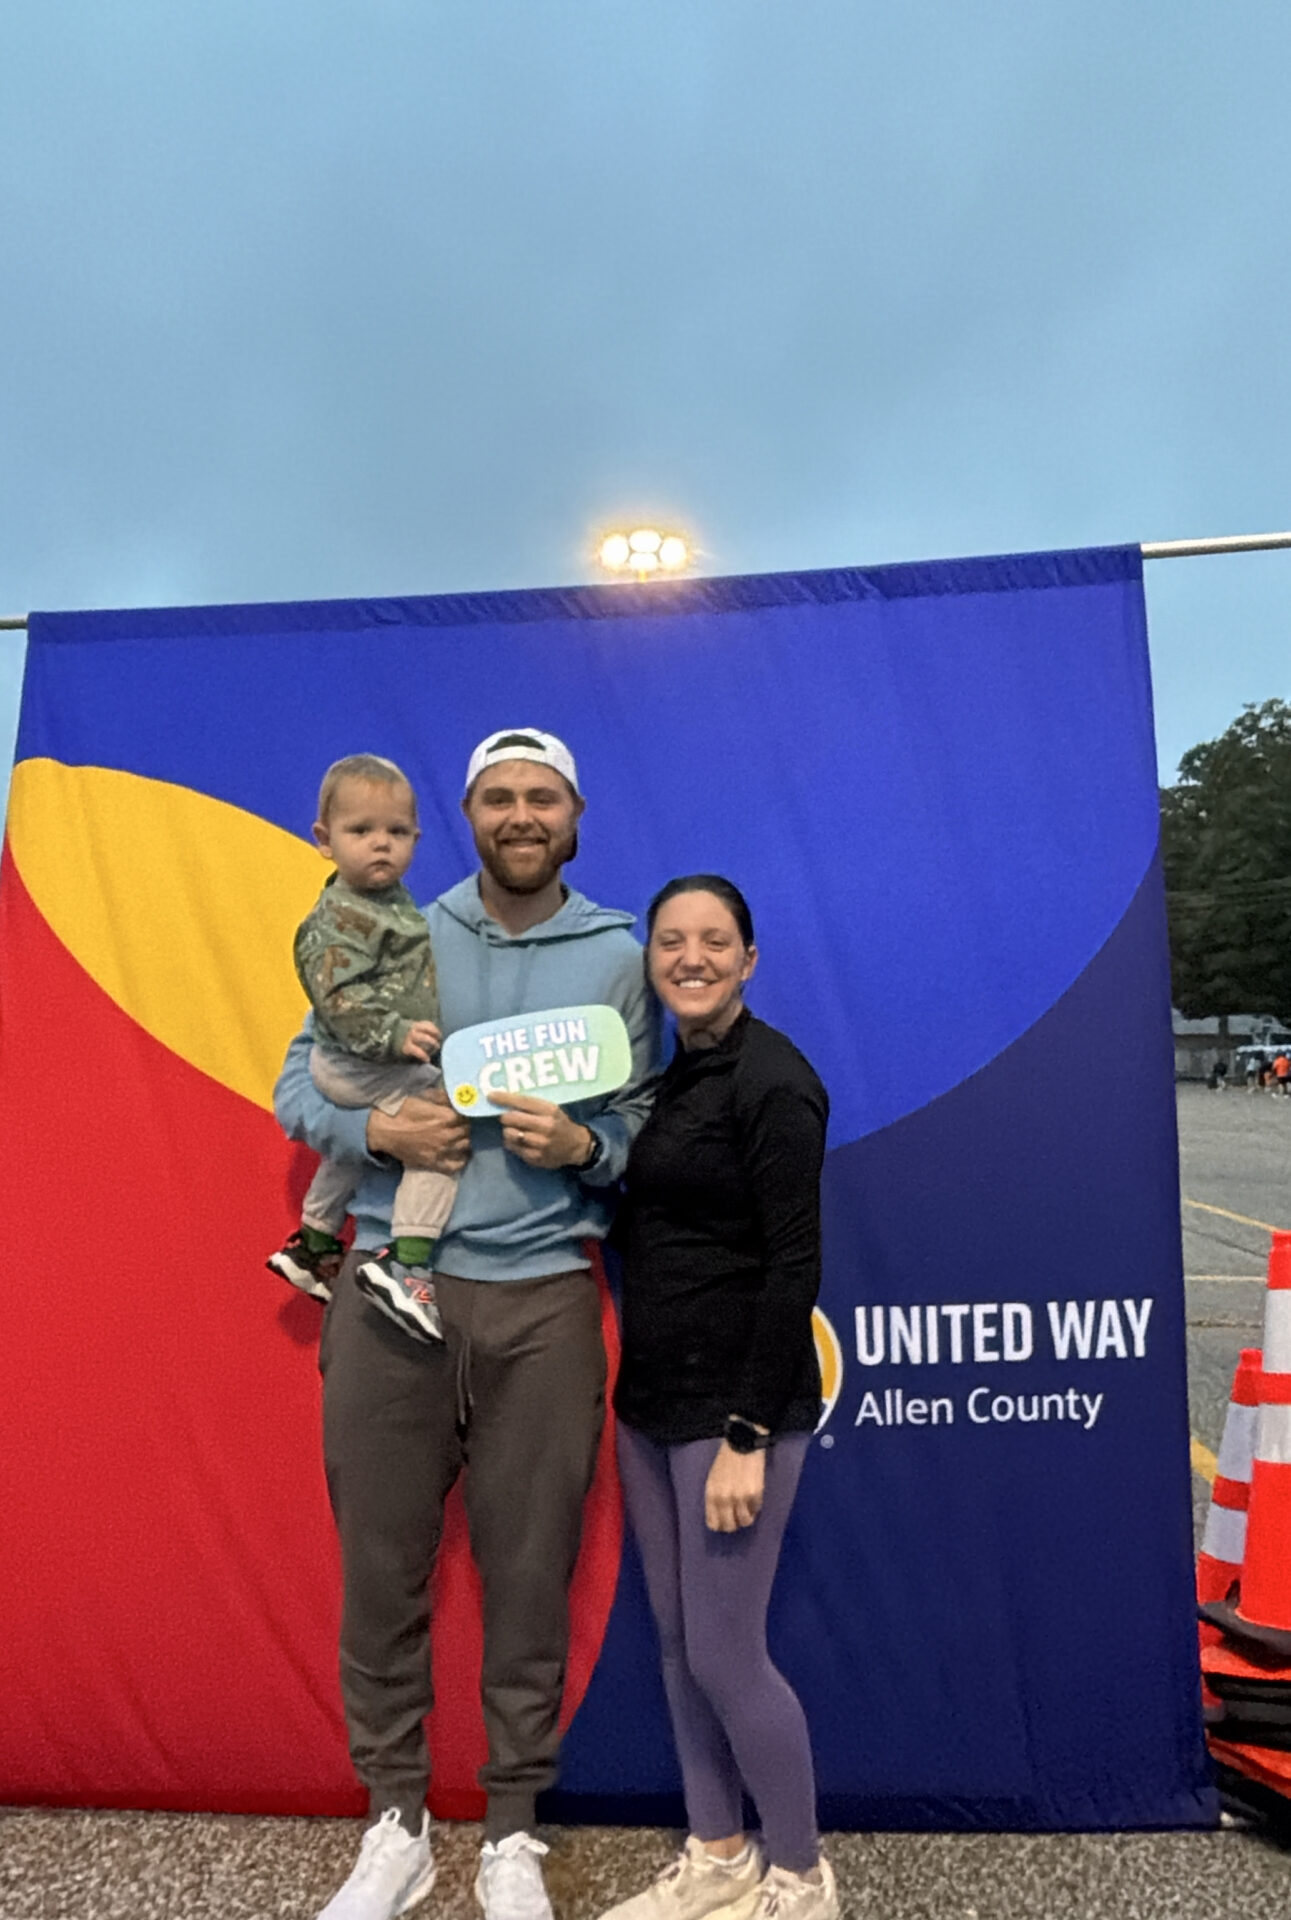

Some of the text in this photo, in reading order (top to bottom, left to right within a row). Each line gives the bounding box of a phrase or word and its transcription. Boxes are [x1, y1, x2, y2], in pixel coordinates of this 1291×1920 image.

[480, 1020, 586, 1058] THE FUN
[479, 1046, 599, 1098] CREW
[854, 1298, 1153, 1366] UNITED WAY
[854, 1387, 1103, 1430] Allen County
